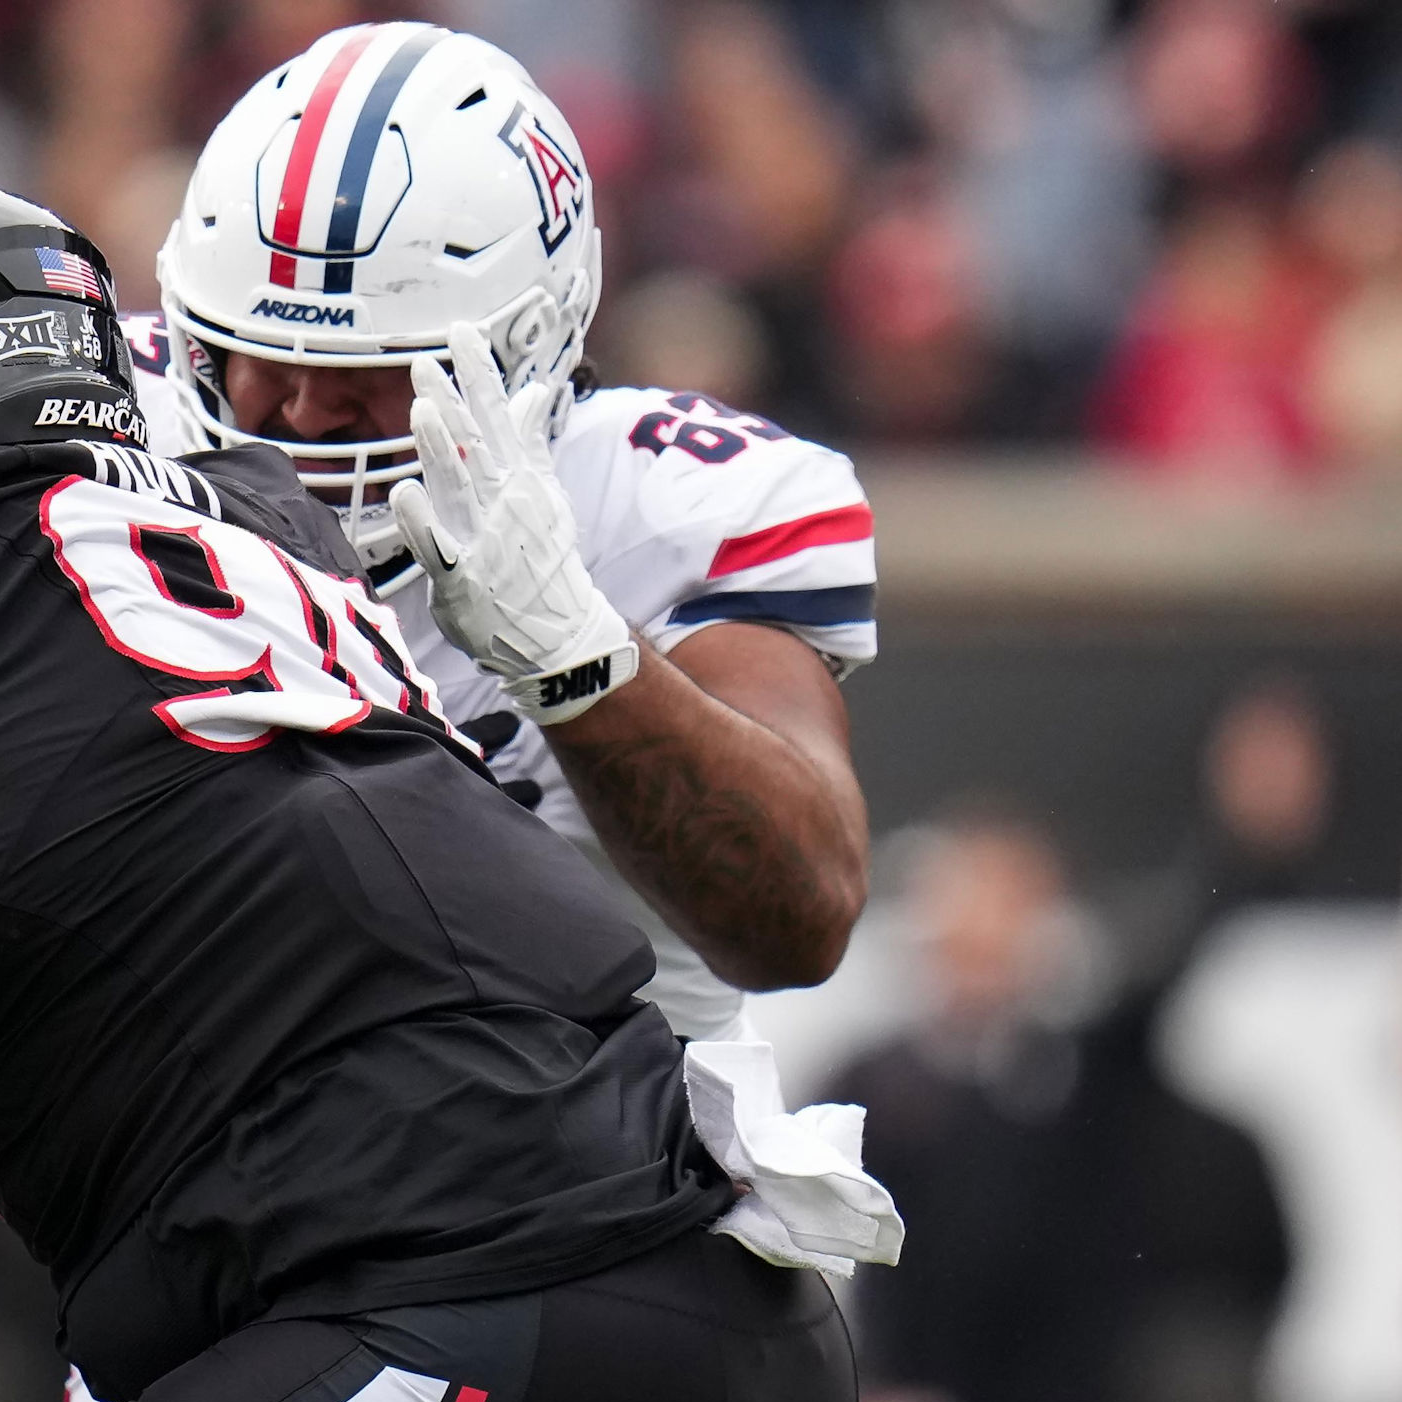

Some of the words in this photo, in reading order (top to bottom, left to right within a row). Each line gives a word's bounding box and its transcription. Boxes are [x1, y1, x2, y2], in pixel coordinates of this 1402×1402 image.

[251, 299, 354, 328] ARIZONA
[82, 334, 103, 361] 58
[34, 399, 149, 449] BEARCAT
[539, 655, 611, 709] NIKE
